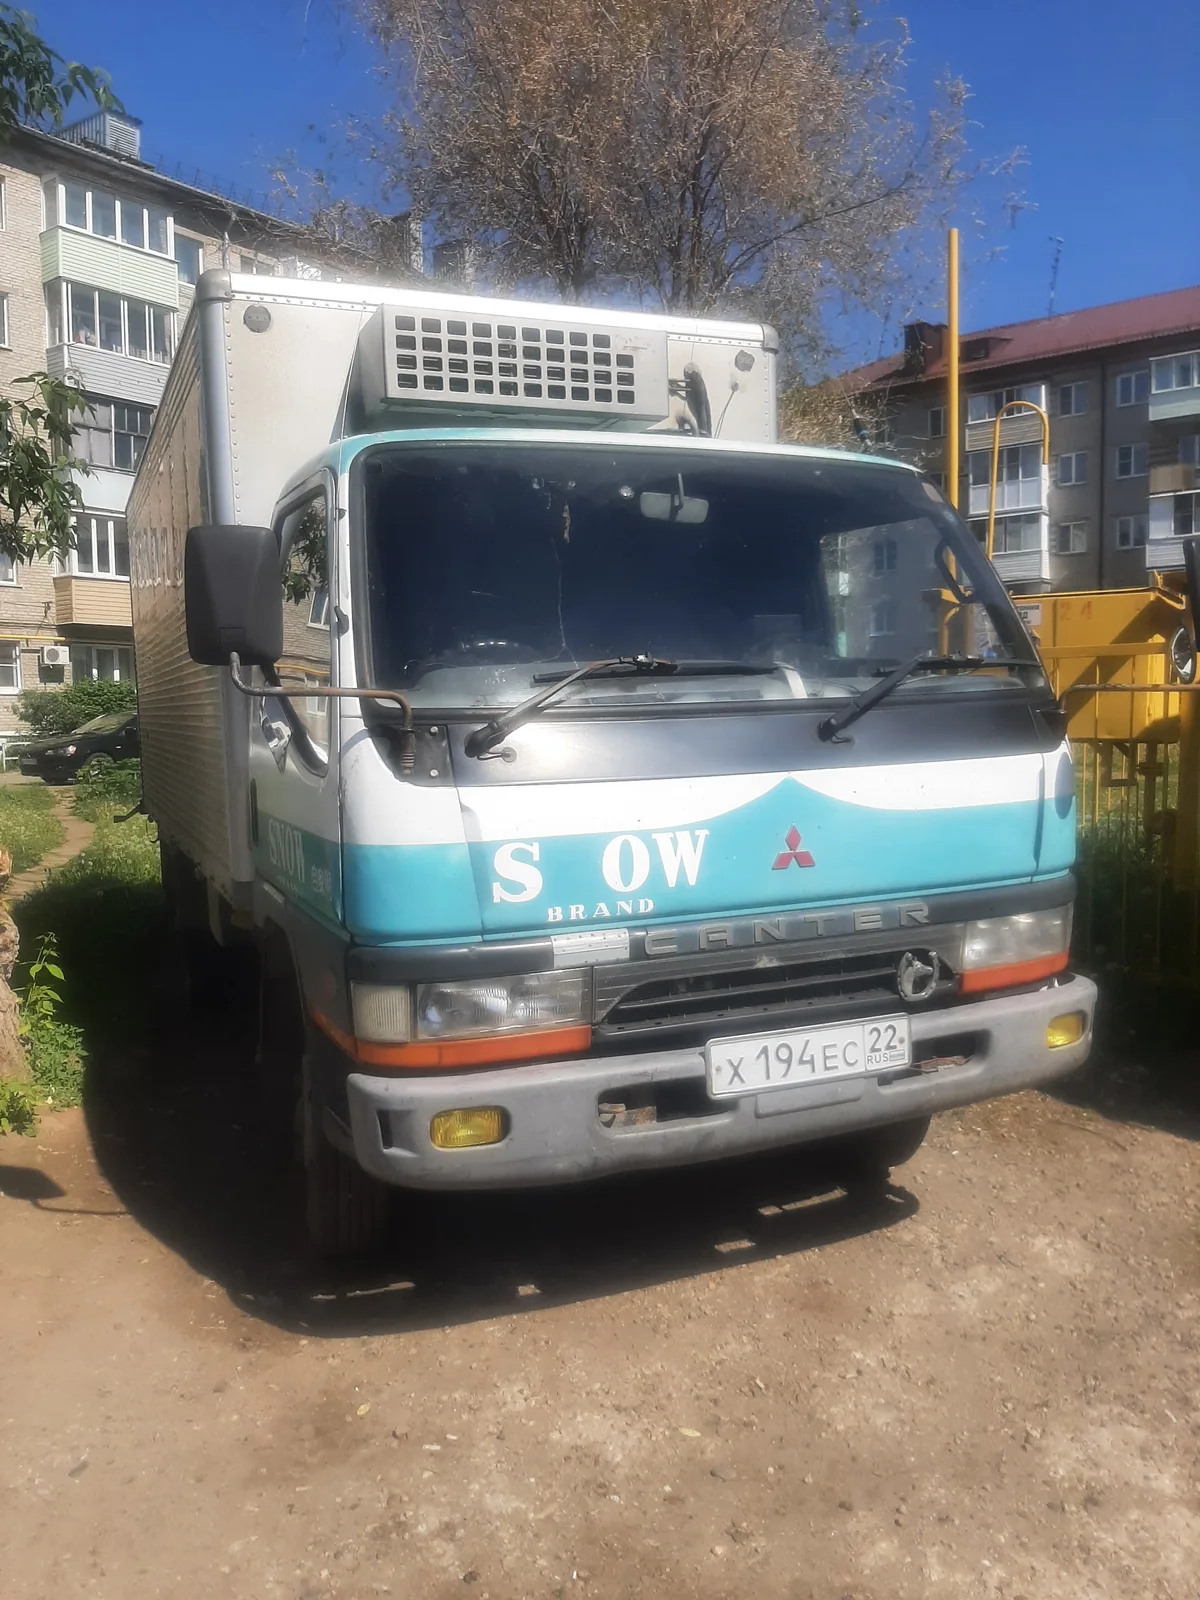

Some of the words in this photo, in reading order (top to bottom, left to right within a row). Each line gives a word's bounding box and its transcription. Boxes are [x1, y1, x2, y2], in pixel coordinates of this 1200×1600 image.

[548, 898, 655, 923] BRAND
[643, 902, 931, 956] CANTER
[868, 1025, 898, 1053] 22
[867, 1053, 888, 1066] RUS
